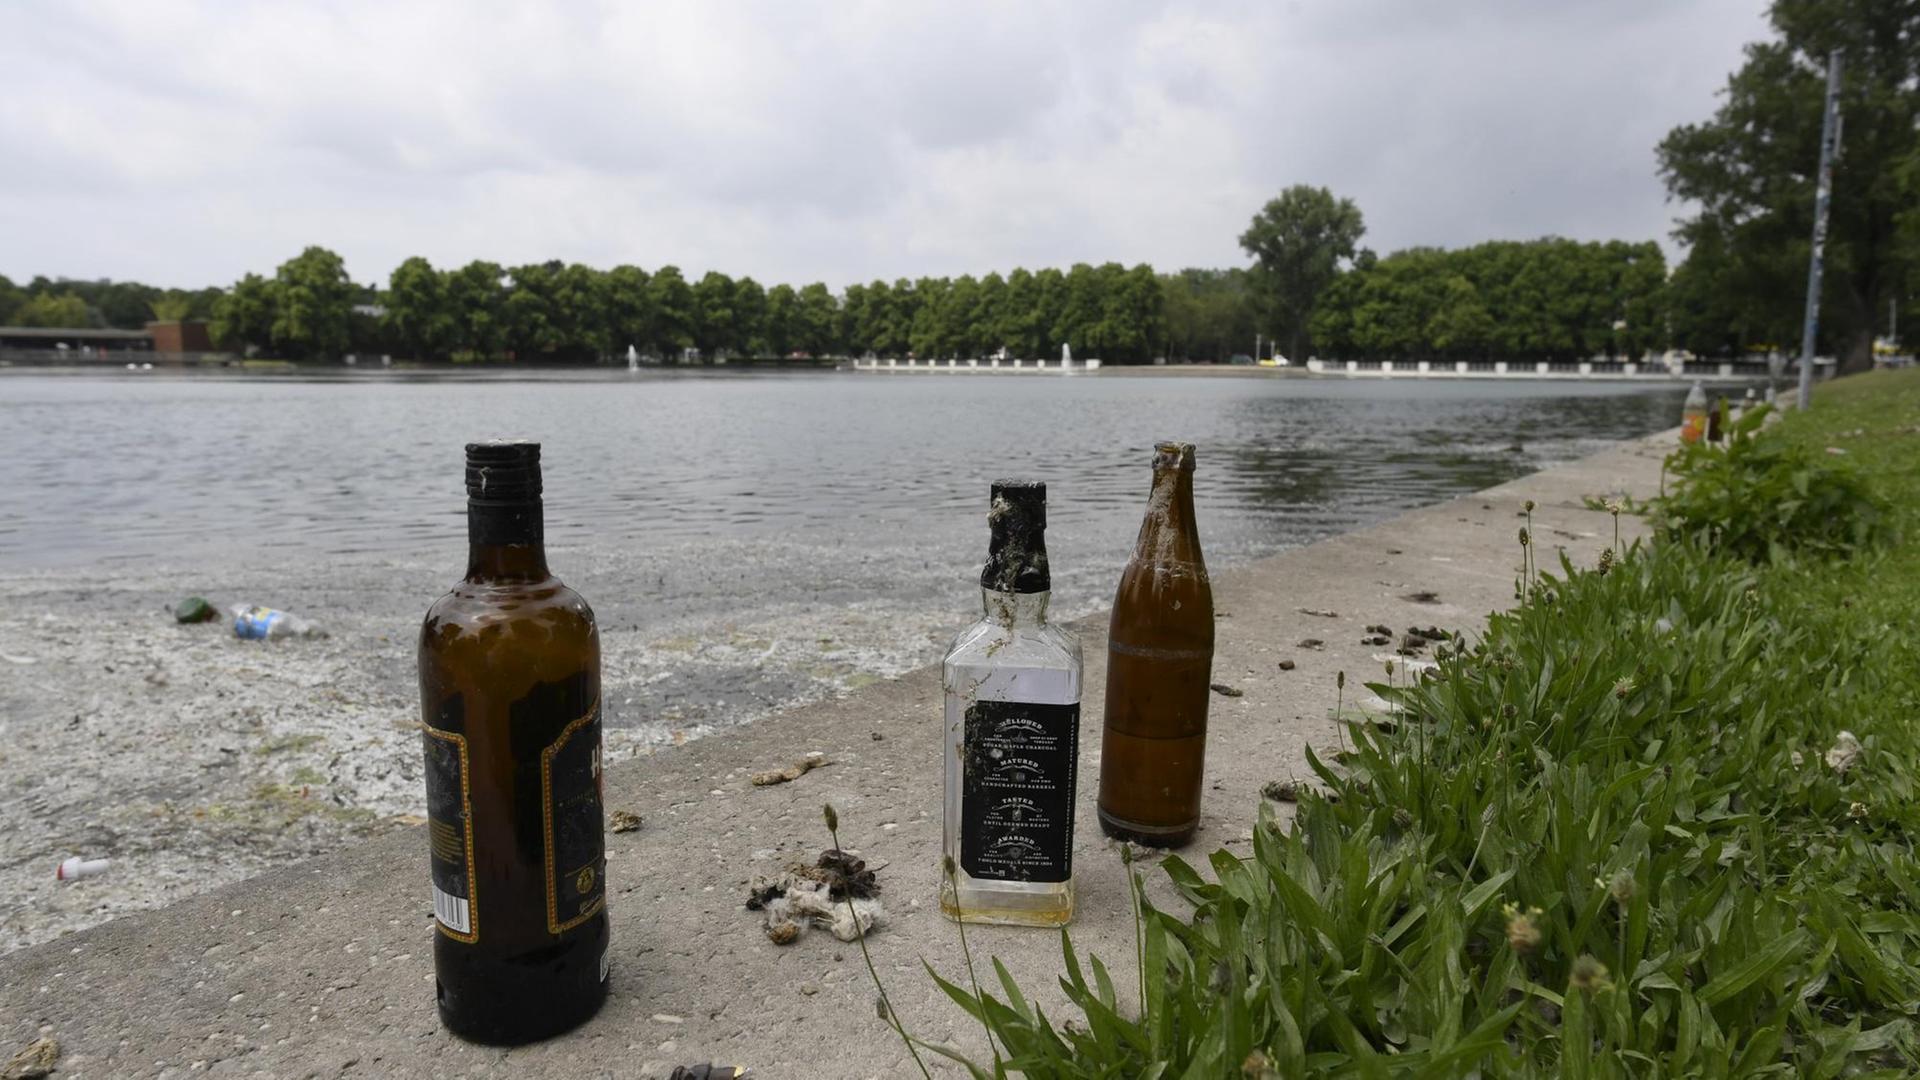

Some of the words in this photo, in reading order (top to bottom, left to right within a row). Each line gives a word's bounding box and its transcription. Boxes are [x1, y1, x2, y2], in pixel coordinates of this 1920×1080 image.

[999, 718, 1043, 730] MELLOWED
[1000, 758, 1039, 768] MATURED
[1001, 797, 1034, 805] TASTED
[998, 835, 1035, 845] AWARDED
